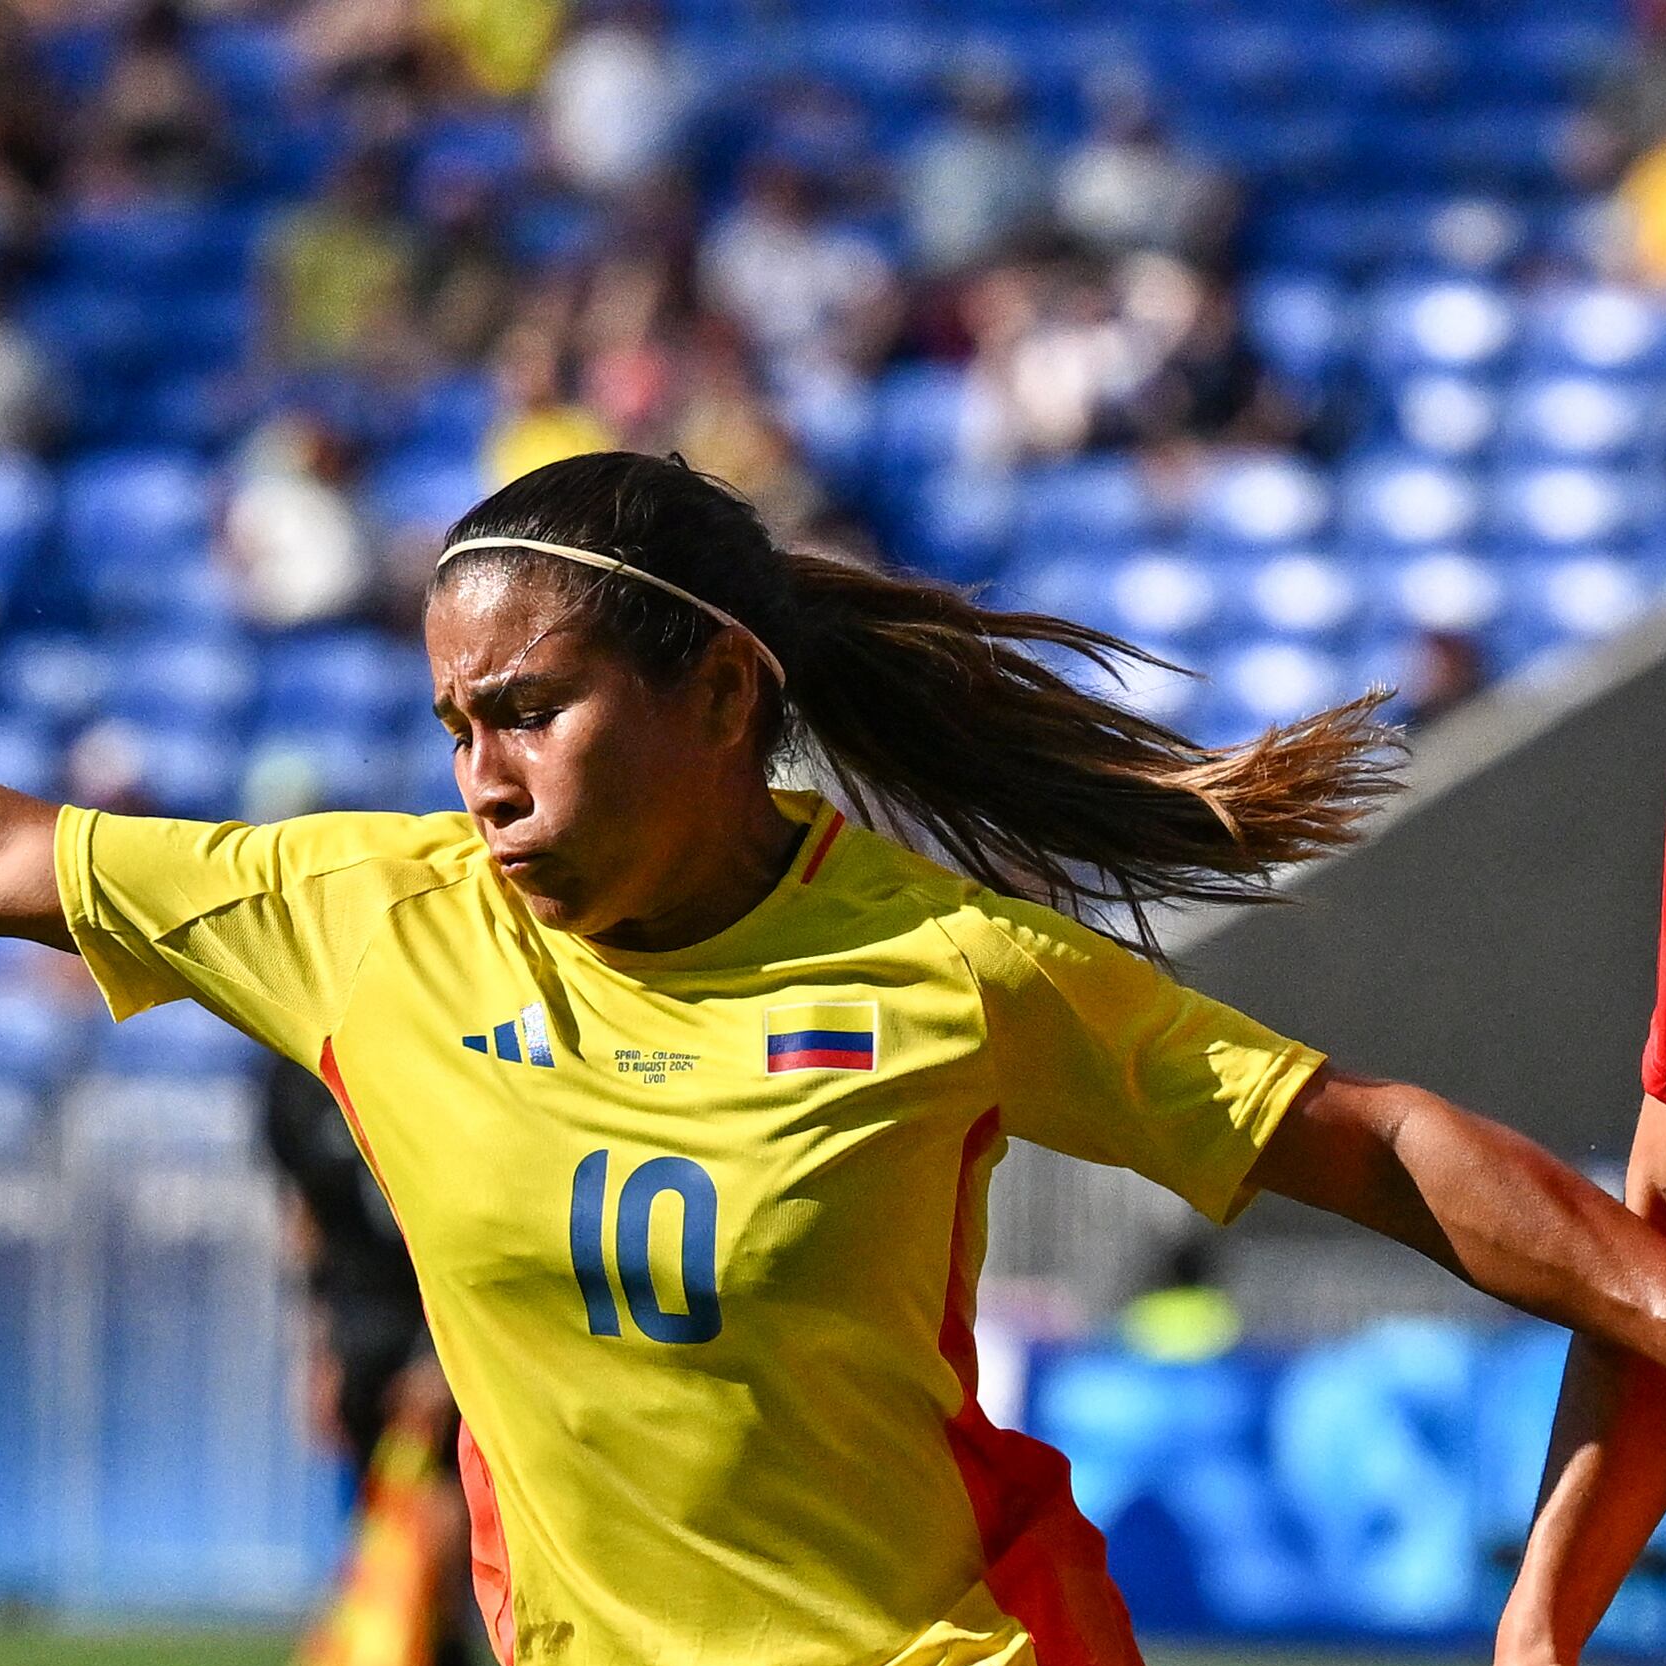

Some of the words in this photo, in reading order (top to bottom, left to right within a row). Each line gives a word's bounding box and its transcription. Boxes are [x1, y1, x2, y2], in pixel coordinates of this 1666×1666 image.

[614, 1049, 641, 1060] SPAIN
[618, 1061, 629, 1072] 03
[632, 1061, 667, 1072] AUGUST
[669, 1060, 694, 1071] 2024
[643, 1073, 666, 1084] LYON
[570, 1149, 723, 1344] 10
